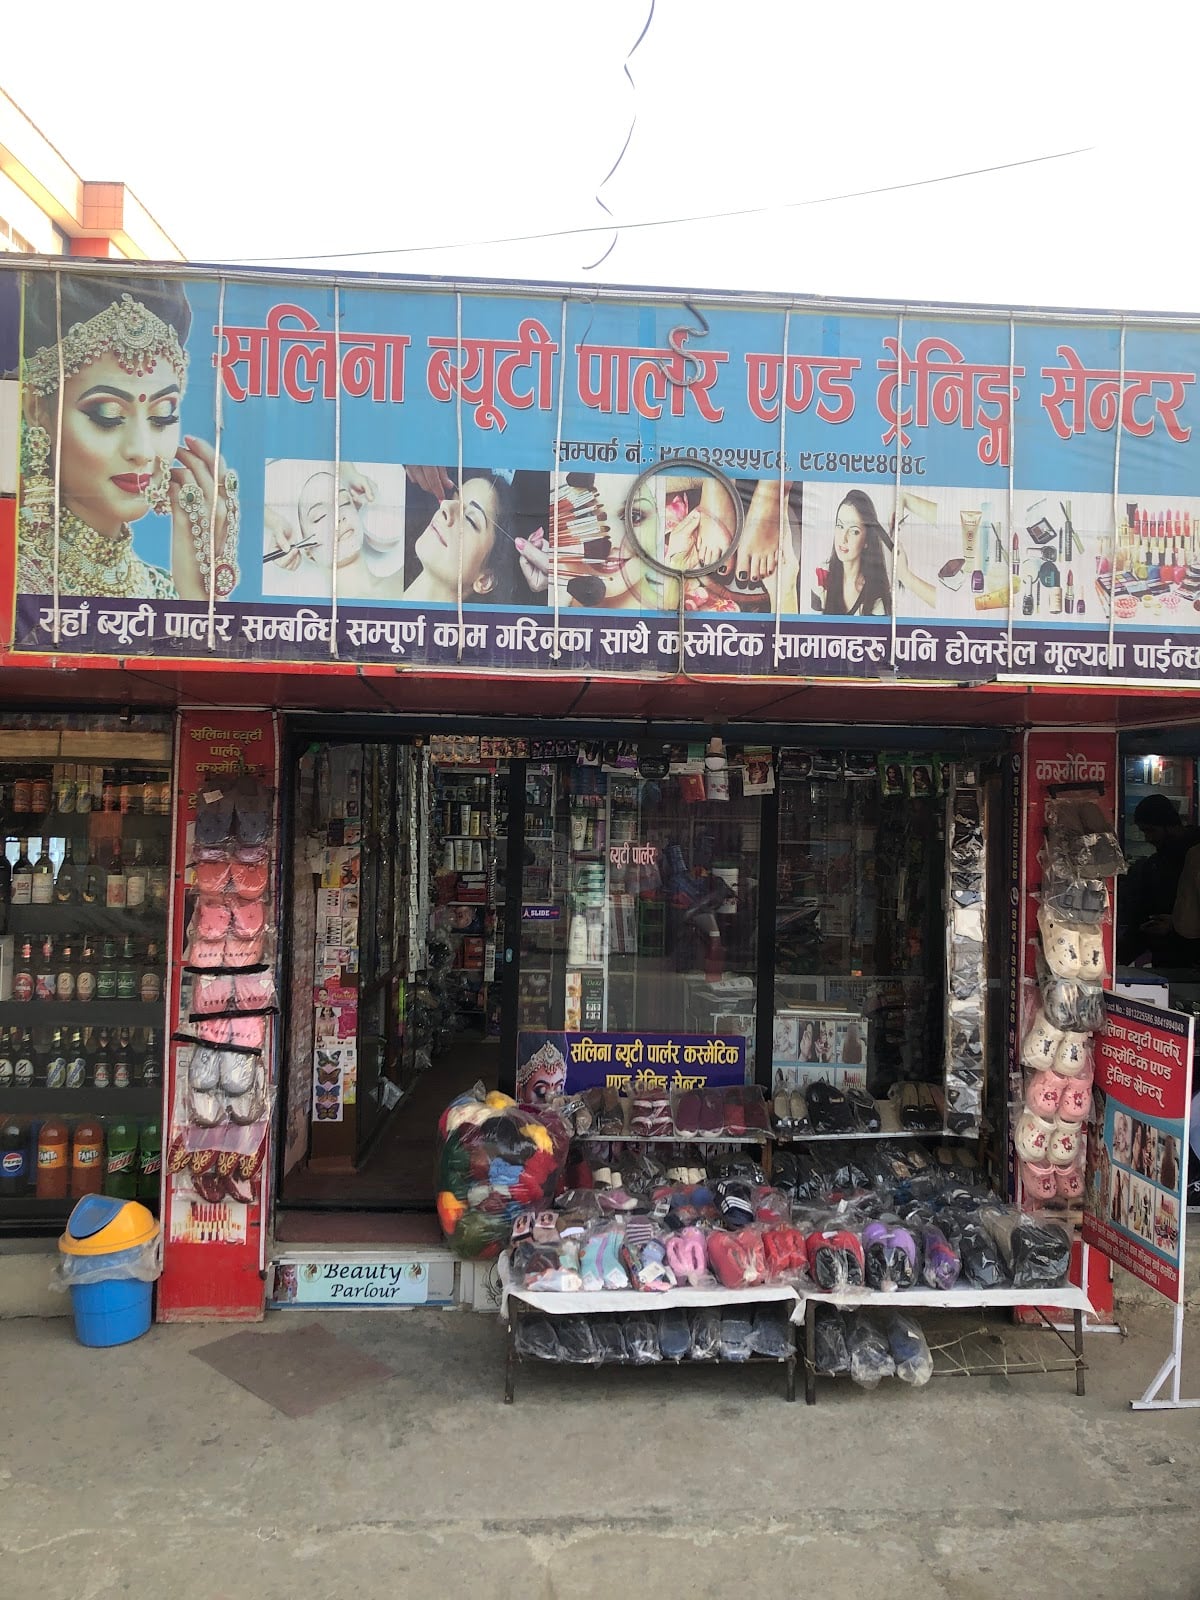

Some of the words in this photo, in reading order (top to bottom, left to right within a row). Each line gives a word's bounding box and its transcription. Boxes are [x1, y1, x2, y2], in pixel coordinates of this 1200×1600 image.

[212, 303, 411, 403] सलिना
[427, 317, 558, 433] ब्यूटी
[575, 328, 729, 423] पार्लर
[745, 353, 862, 424] एण्ड
[1040, 344, 1196, 443] सेन्टर
[553, 437, 619, 463] सम्पर्क
[39, 600, 90, 636] यहाँ
[97, 603, 157, 645] ब्यूटी
[164, 607, 235, 641] पार्लर
[346, 615, 426, 654] सम्पूर्ण
[433, 622, 488, 649] काम
[599, 621, 651, 656] साथै
[658, 623, 765, 658] कस्मेटिक
[895, 629, 939, 663] पनि
[945, 630, 1037, 667] होलसेल
[191, 727, 230, 741] सलिना
[1036, 753, 1106, 784] कस्मेटिक
[632, 842, 656, 865] पार्लर
[570, 1036, 612, 1064] सलिना
[616, 1037, 644, 1069] ब्यूटी
[647, 1039, 681, 1065] पार्लर
[684, 1039, 739, 1065] कस्मेटिक
[1102, 1043, 1149, 1071] कस्मेटिक
[1149, 1060, 1173, 1080] एण्ड
[1127, 1029, 1151, 1051] ब्यूटी
[1153, 1038, 1183, 1066] पार्लर
[1133, 1074, 1165, 1108] सेन्टर
[324, 1264, 402, 1286] Beauty
[331, 1282, 400, 1298] Parlour
